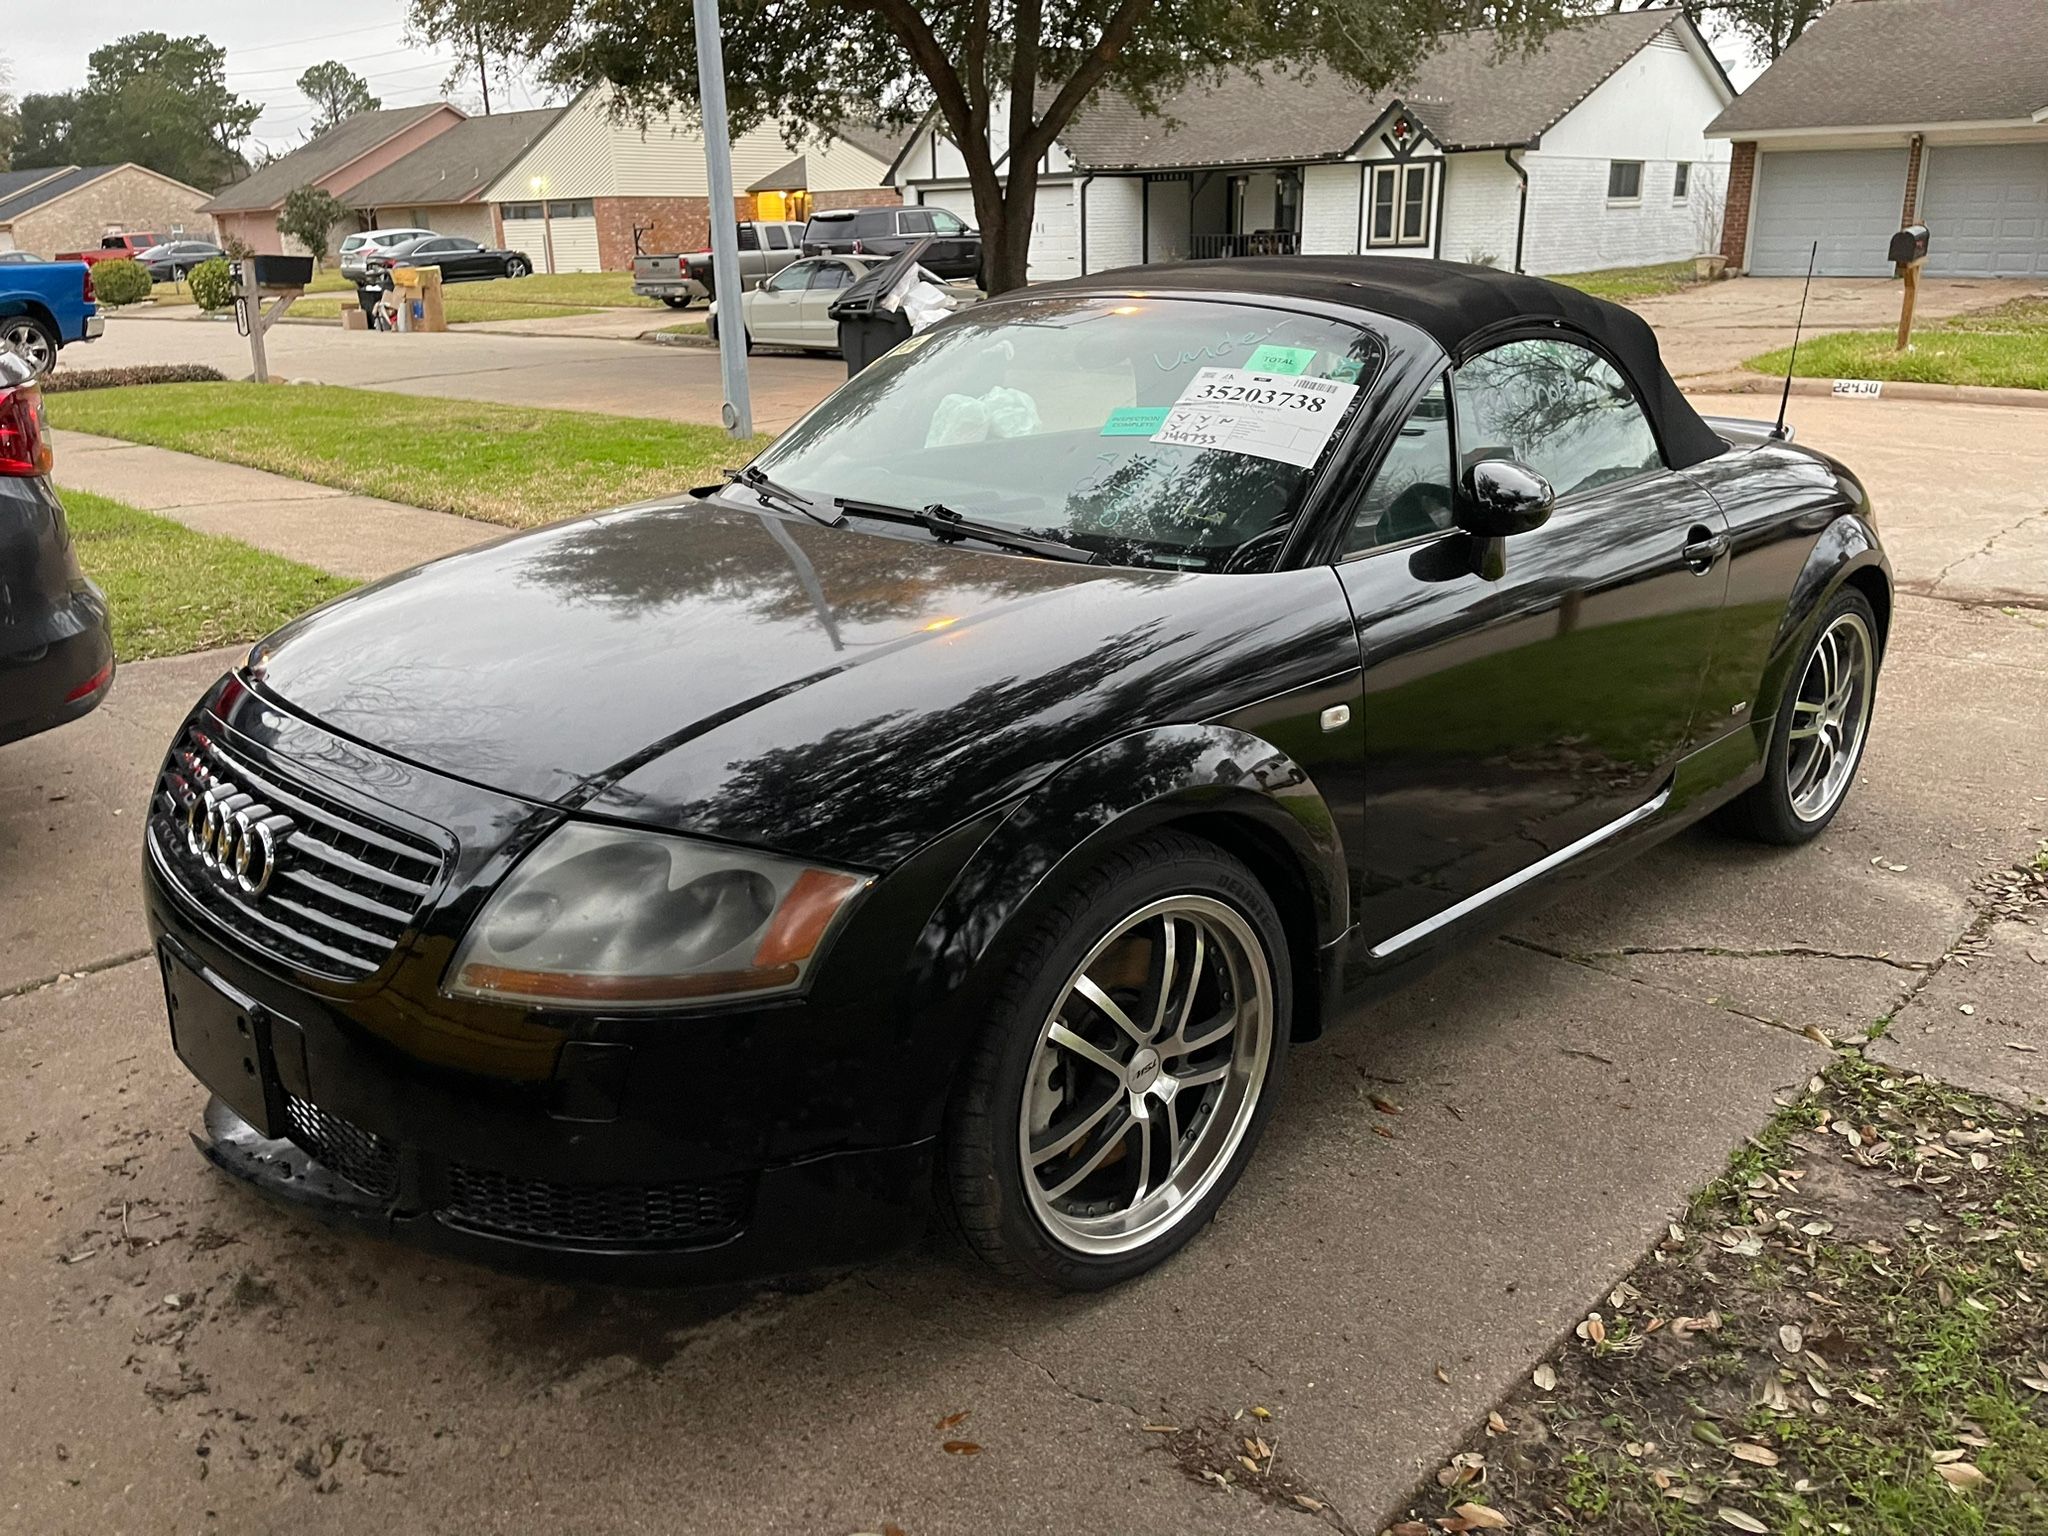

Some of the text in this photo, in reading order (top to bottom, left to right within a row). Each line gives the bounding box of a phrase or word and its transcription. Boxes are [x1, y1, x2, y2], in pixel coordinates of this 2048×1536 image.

[1263, 355, 1295, 366] TOTAL
[1833, 382, 1879, 394] 22430
[1197, 384, 1327, 413] 35203738
